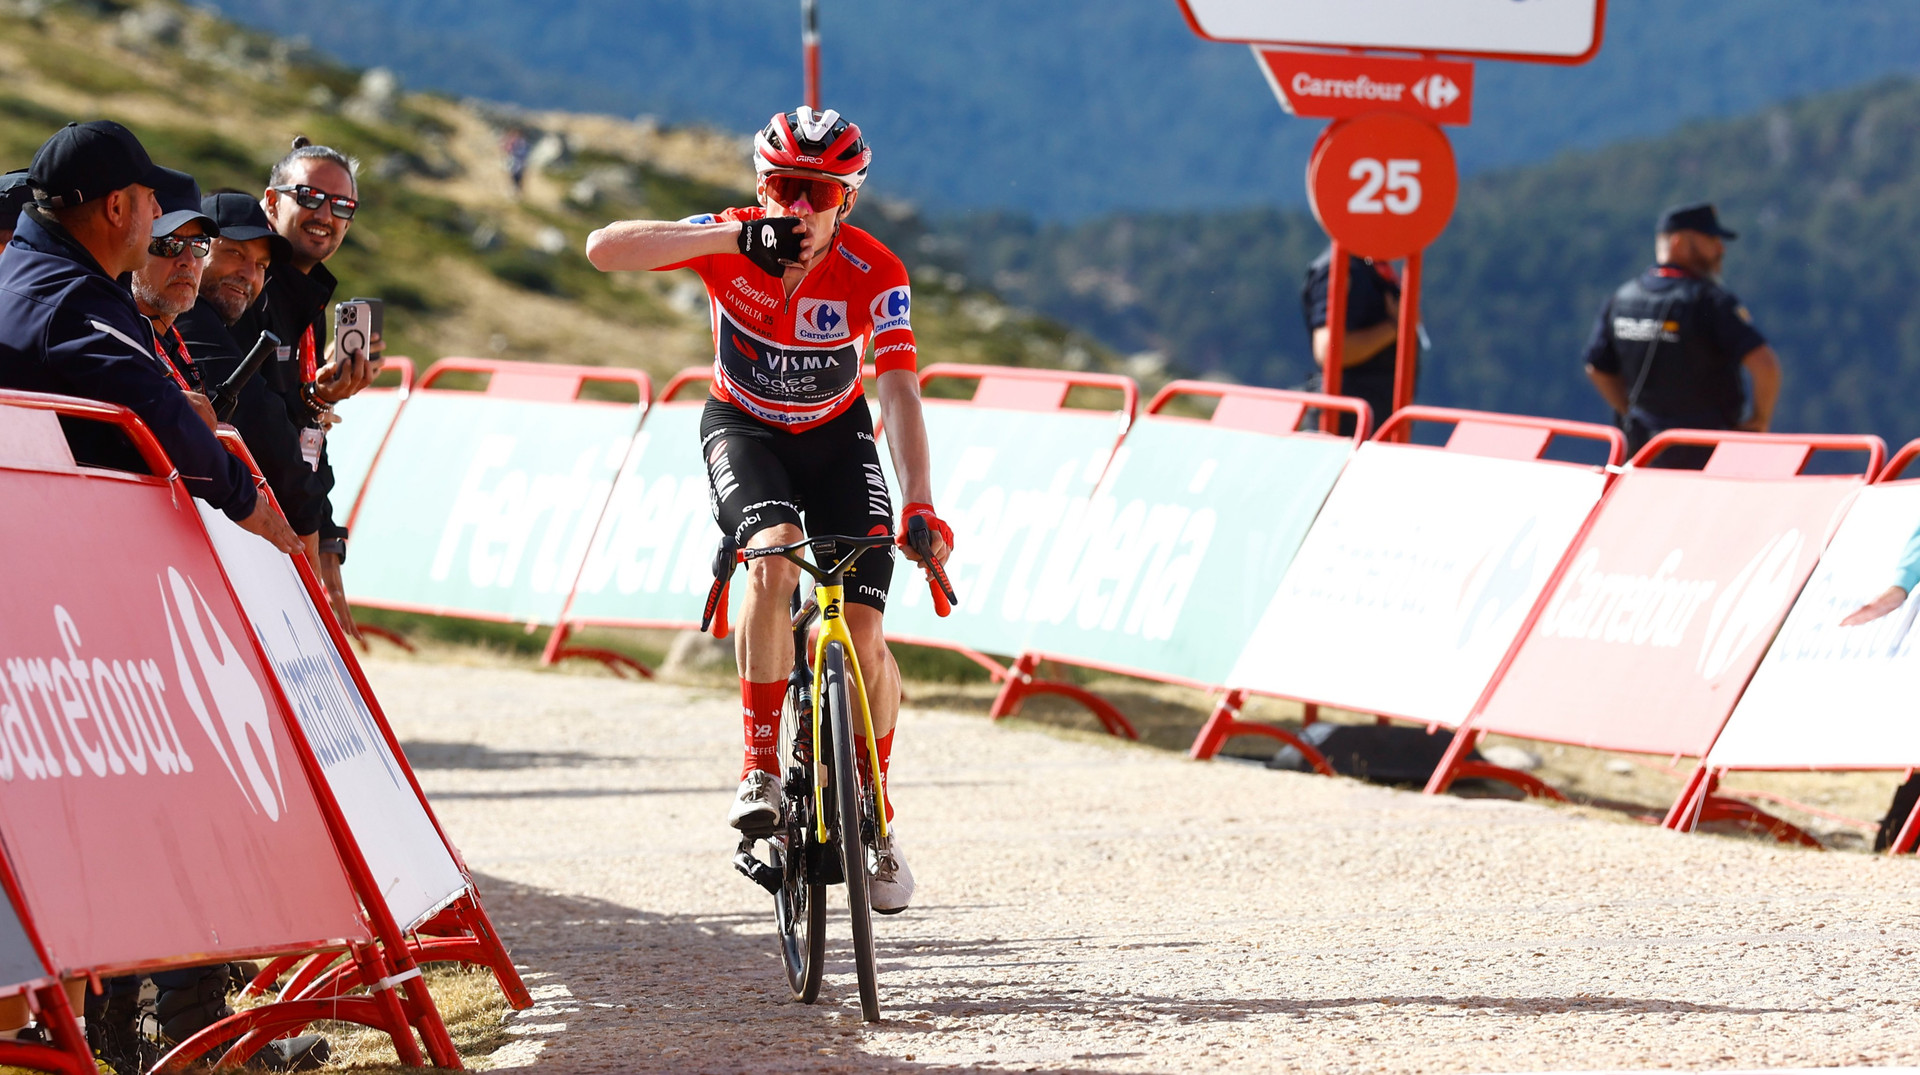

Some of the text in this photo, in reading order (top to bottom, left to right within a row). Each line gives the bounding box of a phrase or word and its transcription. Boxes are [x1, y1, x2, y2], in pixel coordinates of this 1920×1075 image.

[1292, 72, 1406, 101] Carrefour
[796, 155, 824, 165] GIRO
[1347, 157, 1422, 215] 25
[838, 245, 861, 267] Carrefour
[725, 290, 775, 326] LA VUELTA 25
[731, 275, 780, 309] Santini
[800, 329, 845, 340] Carrefour
[875, 316, 911, 333] Carrefo
[751, 366, 816, 390] lease
[765, 351, 840, 372] VISMA
[730, 387, 820, 423] Carrefour
[711, 452, 739, 503] VISMA
[862, 463, 890, 517] VISMA
[734, 513, 762, 545] nimbl
[929, 556, 953, 593] SRAM
[703, 579, 722, 620] SRAM
[859, 584, 887, 603] nimb
[1541, 547, 1717, 647] Carrefour
[0, 604, 194, 781] arrefour
